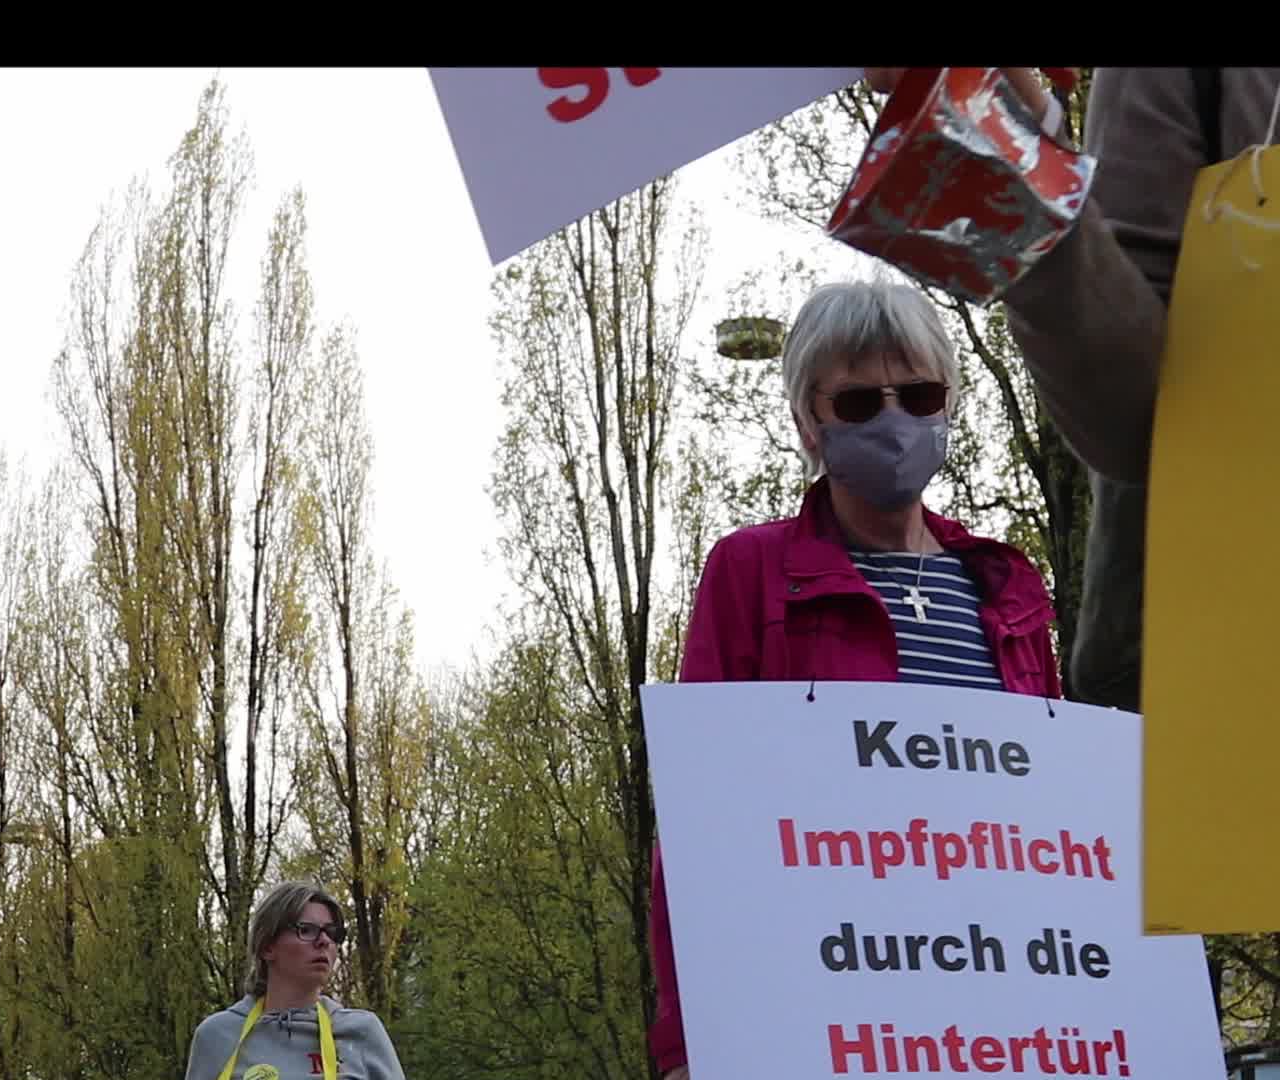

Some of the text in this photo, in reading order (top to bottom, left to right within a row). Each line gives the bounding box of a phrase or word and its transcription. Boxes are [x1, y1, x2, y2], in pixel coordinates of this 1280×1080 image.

[852, 719, 1032, 777] Keine
[777, 817, 1116, 881] Impfpflicht
[819, 922, 1111, 978] durch die
[826, 1023, 1131, 1077] Hintertür!
